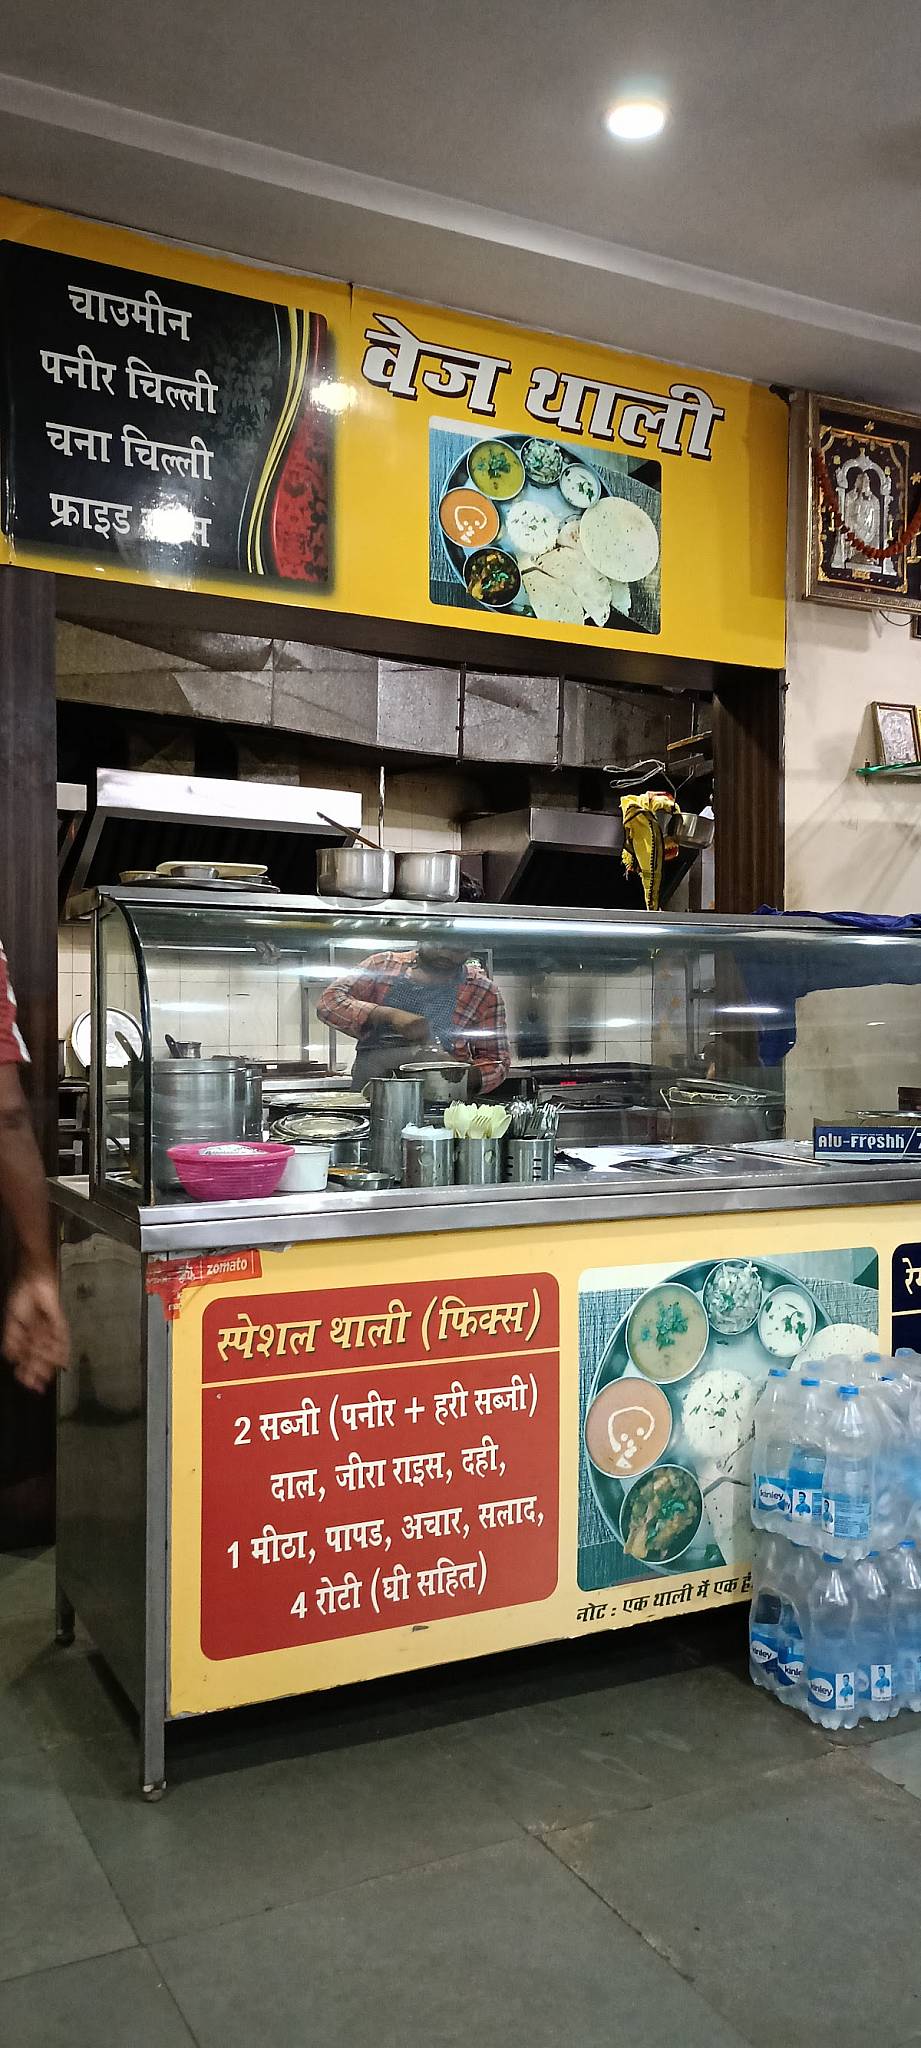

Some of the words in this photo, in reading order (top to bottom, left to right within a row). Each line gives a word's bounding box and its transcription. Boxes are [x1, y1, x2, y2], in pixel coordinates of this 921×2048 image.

[67, 290, 192, 342] चाउमीन
[39, 345, 117, 396] पनीर
[125, 356, 219, 414] चिल्ली
[361, 313, 512, 417] वेज
[524, 366, 725, 461] थाली
[46, 422, 113, 463] चना
[121, 424, 214, 481] चिल्ली
[49, 493, 132, 540] फ्राइड
[206, 1257, 249, 1276] zomato
[217, 1313, 323, 1362] स्पेशल
[330, 1298, 413, 1349] थाली
[421, 1287, 541, 1352] (फिक्स)
[234, 1416, 251, 1446] 2
[259, 1397, 321, 1441] सब्जी
[329, 1389, 397, 1442] (पनीर
[433, 1380, 469, 1426] हरी
[473, 1373, 538, 1418] सब्जी)
[270, 1469, 326, 1503] दाल,
[334, 1451, 387, 1491] जीरा
[392, 1452, 453, 1487] राइस,
[461, 1434, 506, 1478] दही,
[227, 1541, 239, 1569] 1
[250, 1524, 316, 1564] मीठा,
[325, 1519, 392, 1552] पापड,
[401, 1507, 470, 1540] अचार,
[478, 1495, 544, 1530] सलाद,
[290, 1591, 307, 1619] 4
[315, 1571, 362, 1615] रोटी
[417, 1550, 487, 1597] सहित)
[576, 1602, 608, 1622] नोट
[623, 1595, 650, 1613] एक
[653, 1583, 693, 1607] थाली
[697, 1580, 710, 1598] में
[714, 1577, 739, 1595] एक
